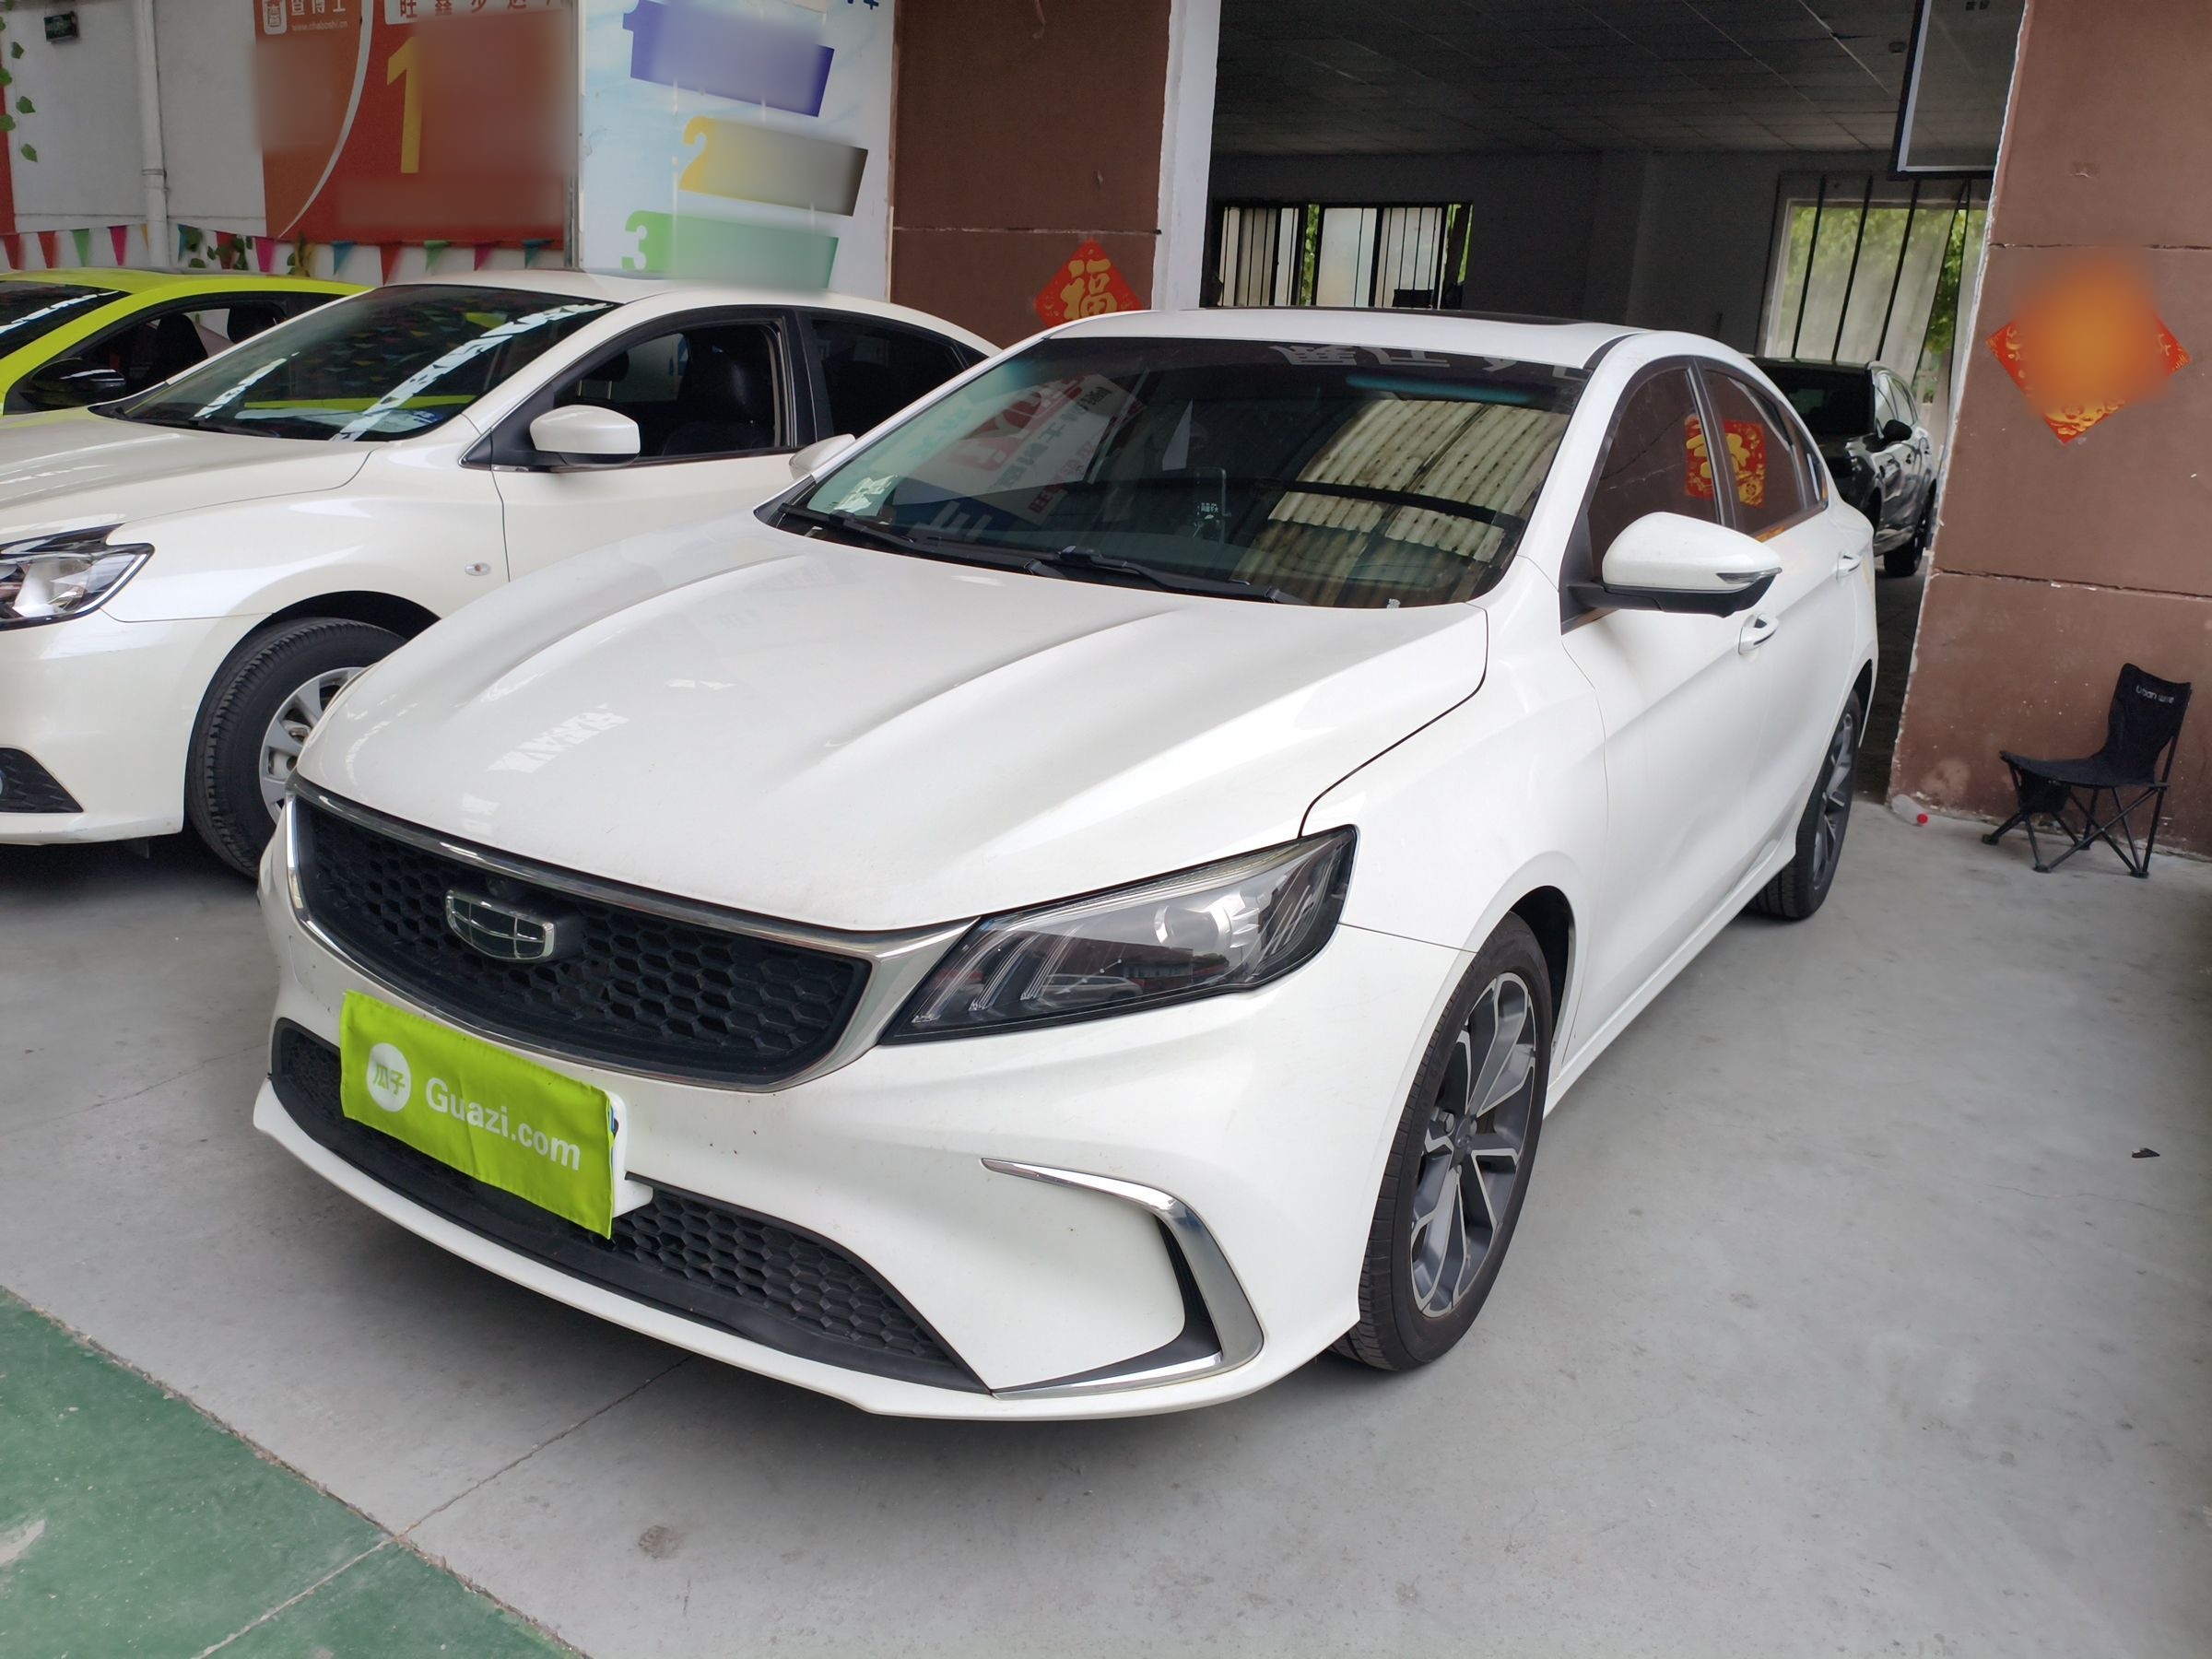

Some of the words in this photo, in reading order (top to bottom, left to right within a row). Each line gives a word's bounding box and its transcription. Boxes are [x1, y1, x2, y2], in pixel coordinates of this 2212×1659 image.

[1060, 259, 1118, 320] 福
[372, 1064, 406, 1096] 瓜子
[426, 1077, 582, 1171] Guazi.com
